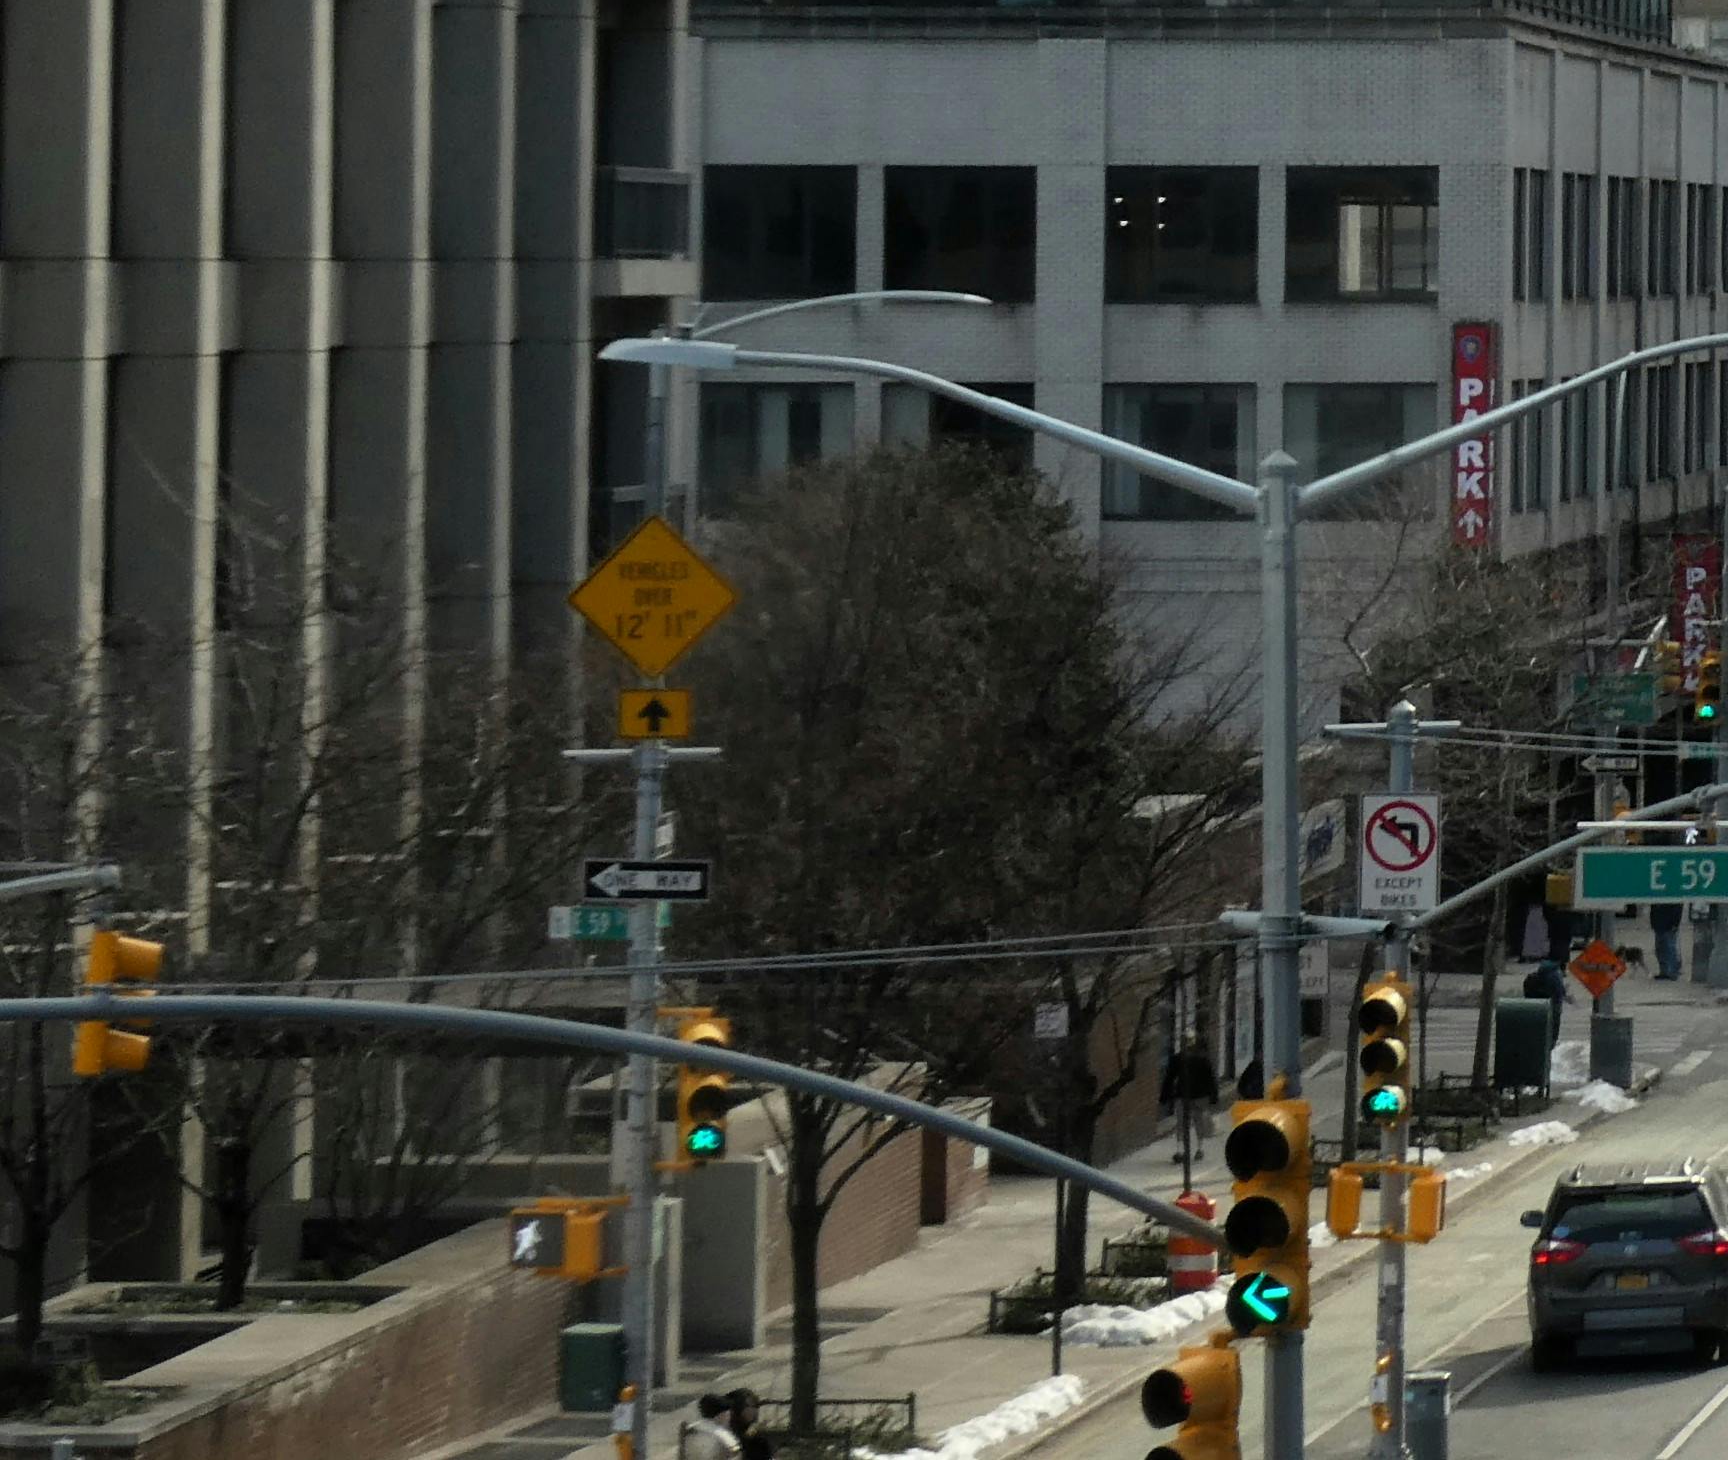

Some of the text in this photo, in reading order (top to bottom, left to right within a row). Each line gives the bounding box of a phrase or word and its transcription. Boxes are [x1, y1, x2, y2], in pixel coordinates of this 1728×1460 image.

[1650, 859, 1667, 890] E
[1681, 859, 1717, 891] 59
[1375, 877, 1425, 890] EXCEPT
[1380, 893, 1418, 907] BIKES
